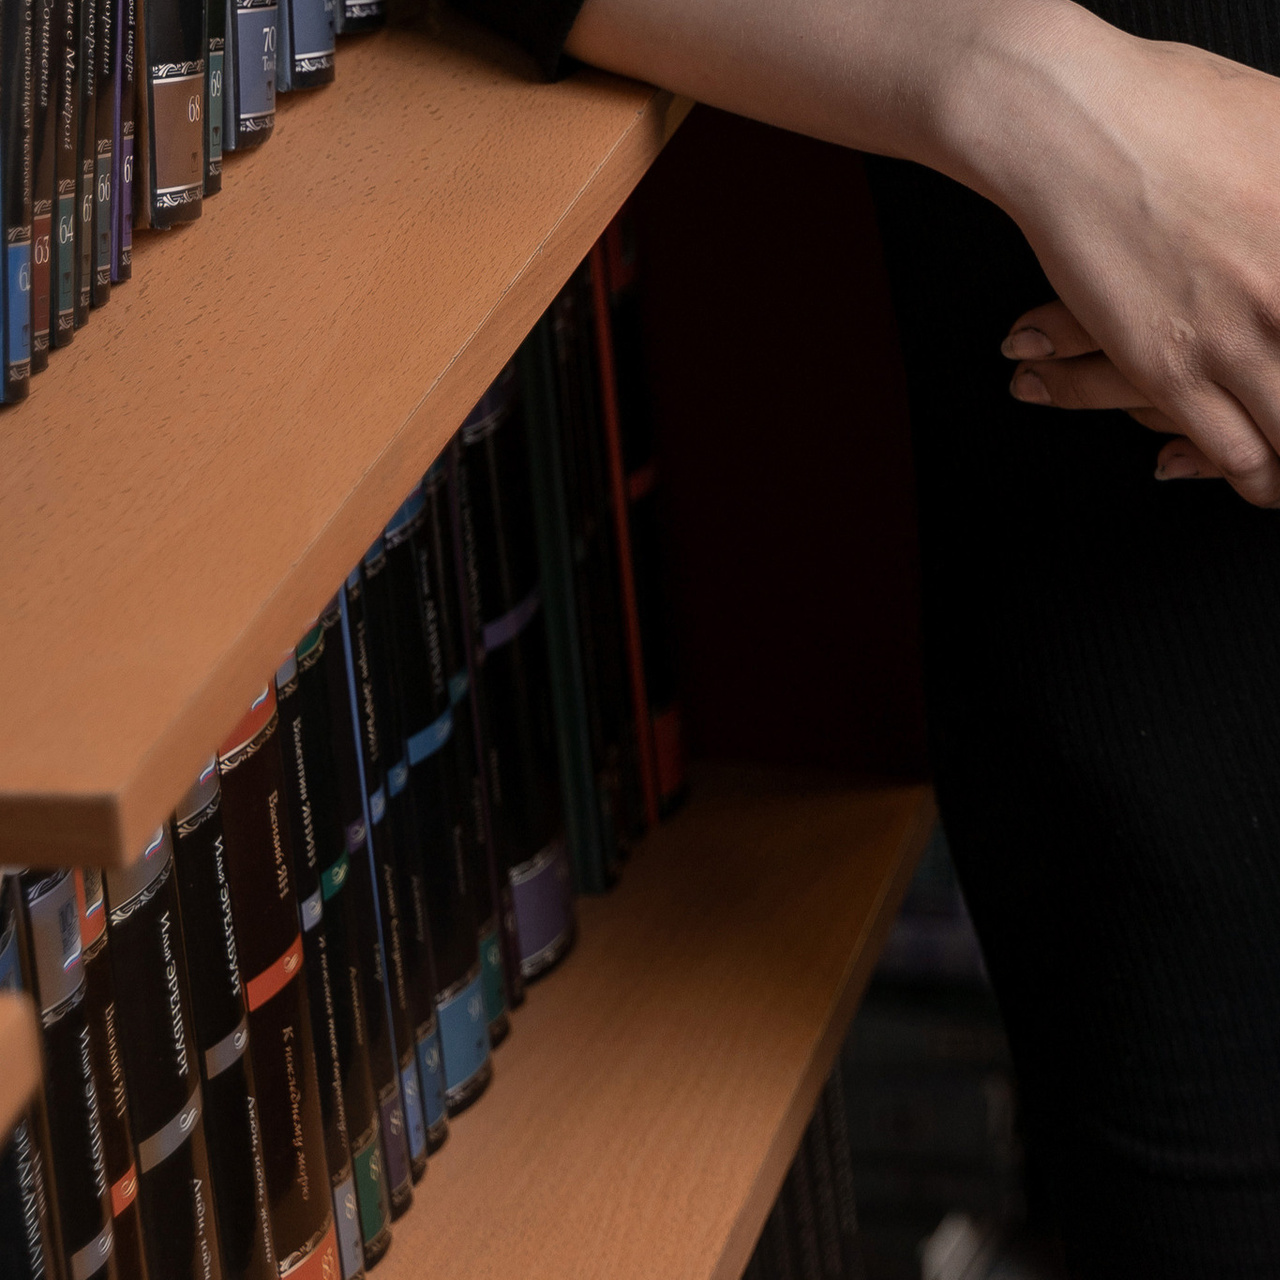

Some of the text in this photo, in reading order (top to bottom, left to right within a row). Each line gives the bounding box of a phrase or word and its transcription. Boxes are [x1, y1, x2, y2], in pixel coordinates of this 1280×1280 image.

[126, 32, 136, 82] шкуре
[262, 26, 276, 52] 70
[21, 25, 32, 128] настоящем
[63, 45, 75, 151] Матёрой
[211, 70, 222, 96] 69
[188, 94, 201, 123] 68
[98, 174, 111, 202] 66
[124, 155, 134, 184] 67
[59, 216, 75, 245] 64
[83, 194, 93, 223] 65
[34, 236, 50, 265] 63
[268, 789, 290, 900] Василий ЯН
[214, 835, 242, 997] Илья ЭРЕНБУРГ
[160, 910, 189, 1078] Илья ЭРЕНБУРГ
[104, 1001, 127, 1120] Василий ЯН
[79, 1024, 107, 1198] Илья ЭРЕНБУРГ
[282, 1025, 310, 1201] К последнему морю
